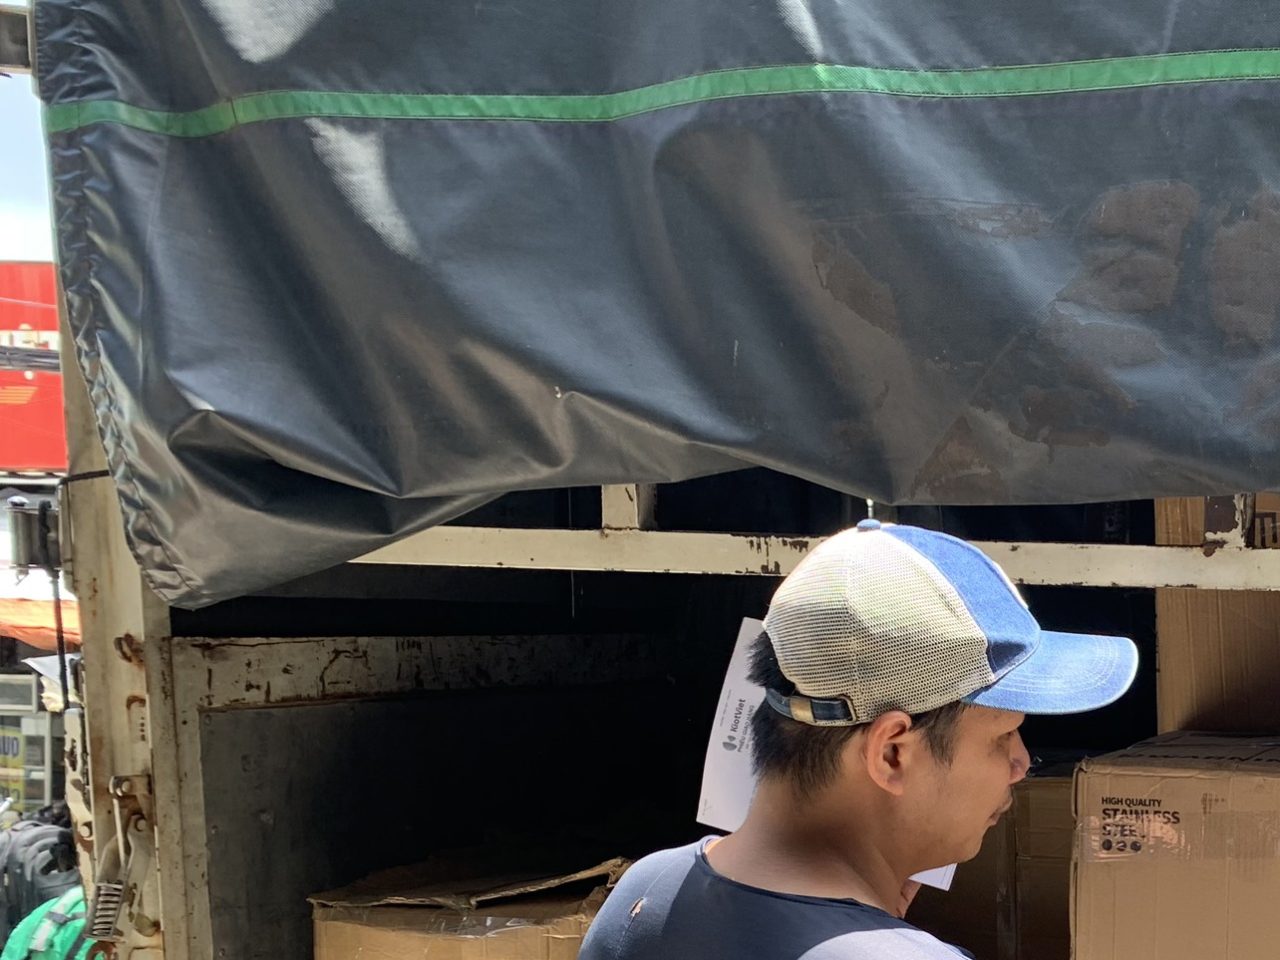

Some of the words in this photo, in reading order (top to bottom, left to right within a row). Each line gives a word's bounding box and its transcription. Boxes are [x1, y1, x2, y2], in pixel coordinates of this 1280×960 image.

[730, 699, 746, 732] KiotViet
[1101, 797, 1123, 806] HIGH
[1125, 799, 1162, 807] QUALITY
